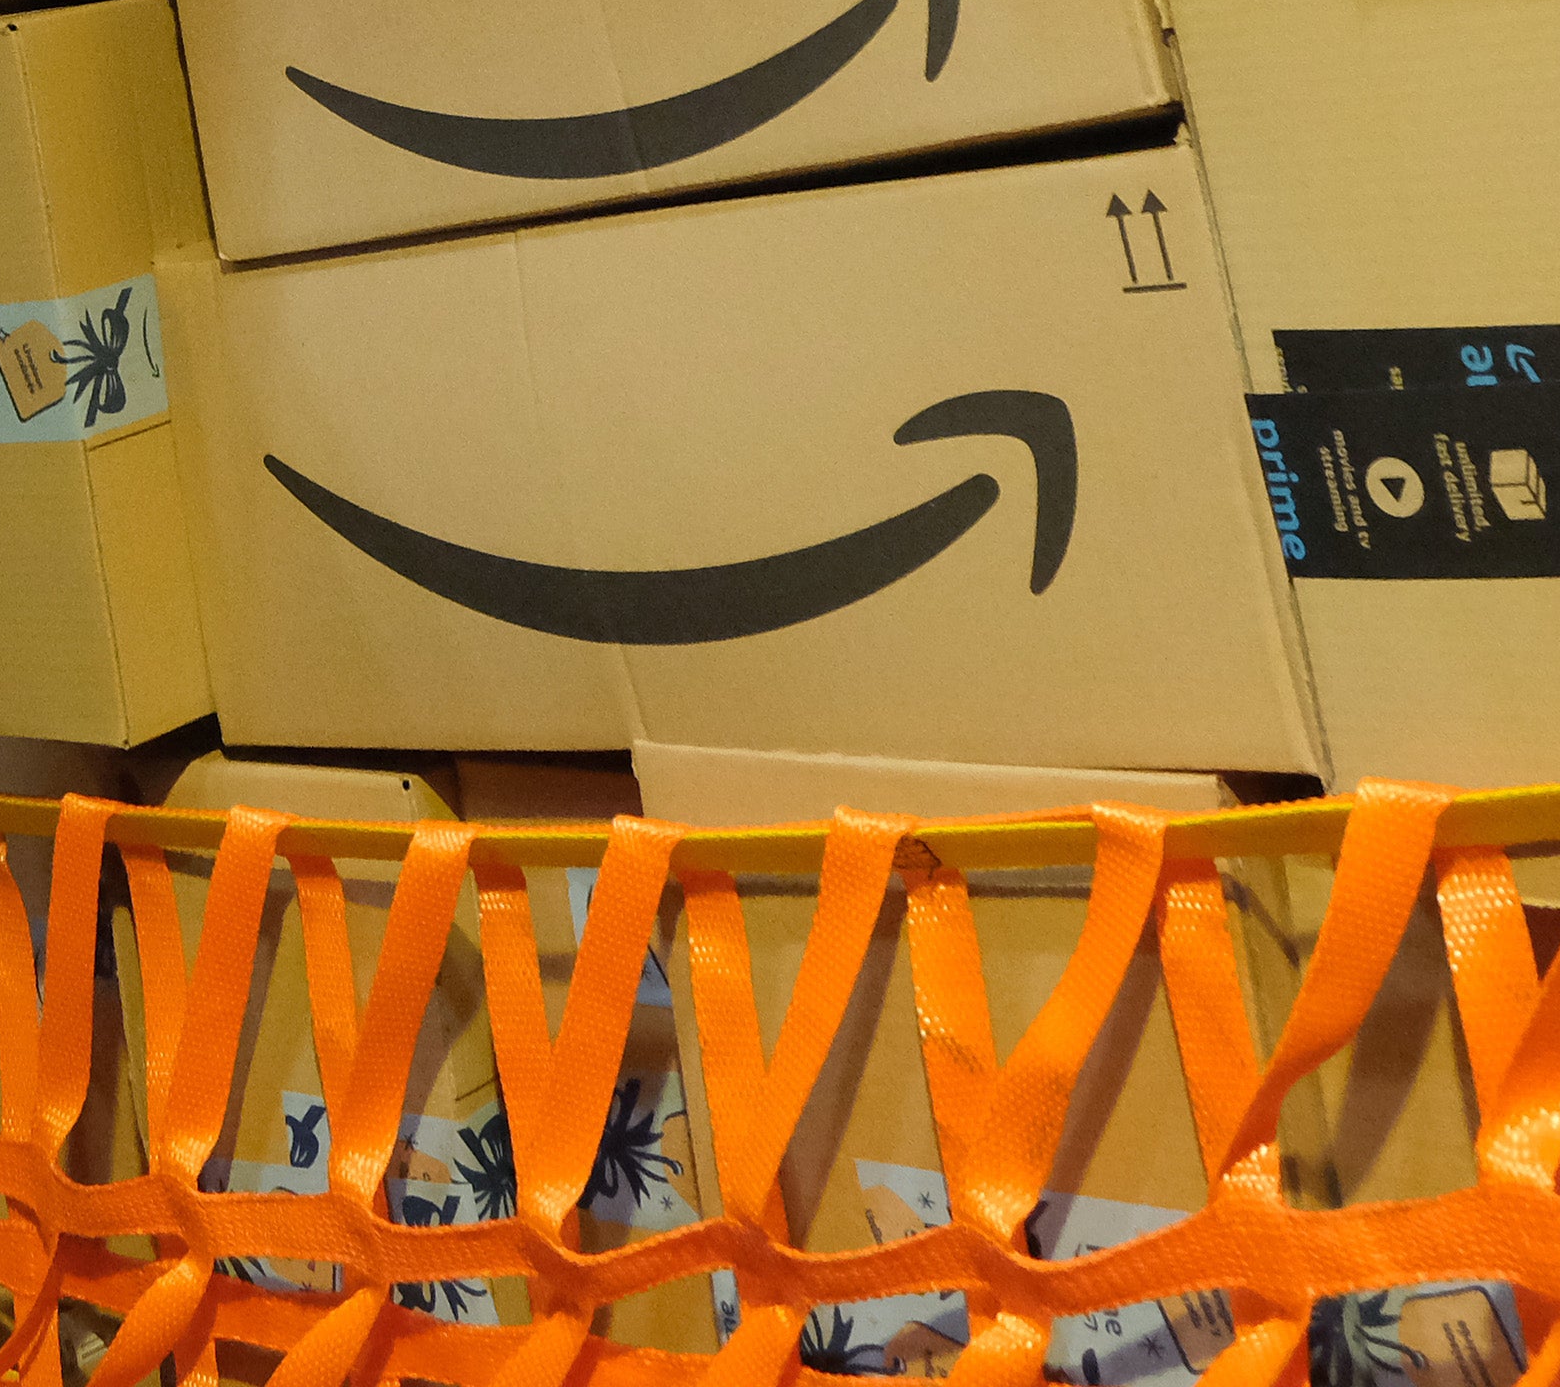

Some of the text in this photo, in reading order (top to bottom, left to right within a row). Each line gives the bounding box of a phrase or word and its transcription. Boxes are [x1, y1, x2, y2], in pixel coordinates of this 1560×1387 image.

[1251, 418, 1307, 562] prime
[1319, 445, 1350, 533] streaming
[1333, 429, 1372, 551] movies and tv
[1432, 432, 1473, 543] fast delivery
[1453, 441, 1492, 533] unlimited,
